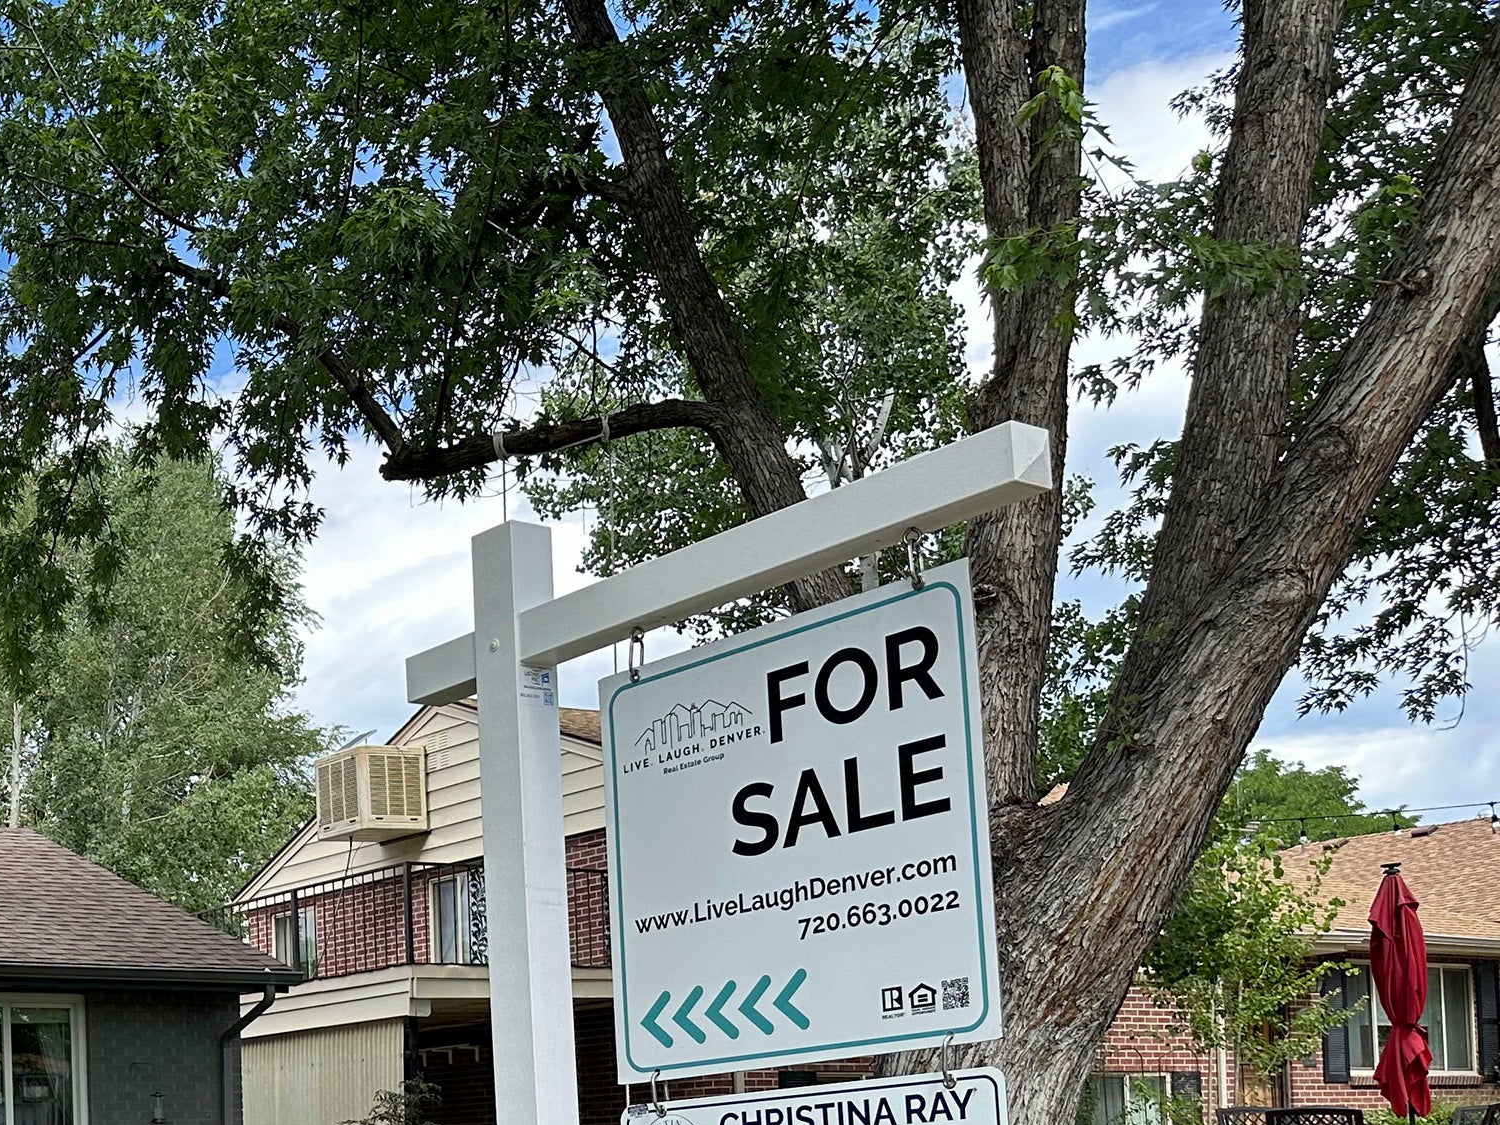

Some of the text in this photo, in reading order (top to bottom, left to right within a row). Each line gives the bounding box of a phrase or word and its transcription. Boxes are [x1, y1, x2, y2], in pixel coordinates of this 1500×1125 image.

[766, 625, 945, 744] FOR
[663, 753, 725, 775] Real Estate Group
[731, 734, 951, 857] SALE
[634, 853, 957, 934] www.LiveLaughDenver.com
[798, 890, 960, 940] 720.663.0022
[906, 1088, 974, 1124] RAY
